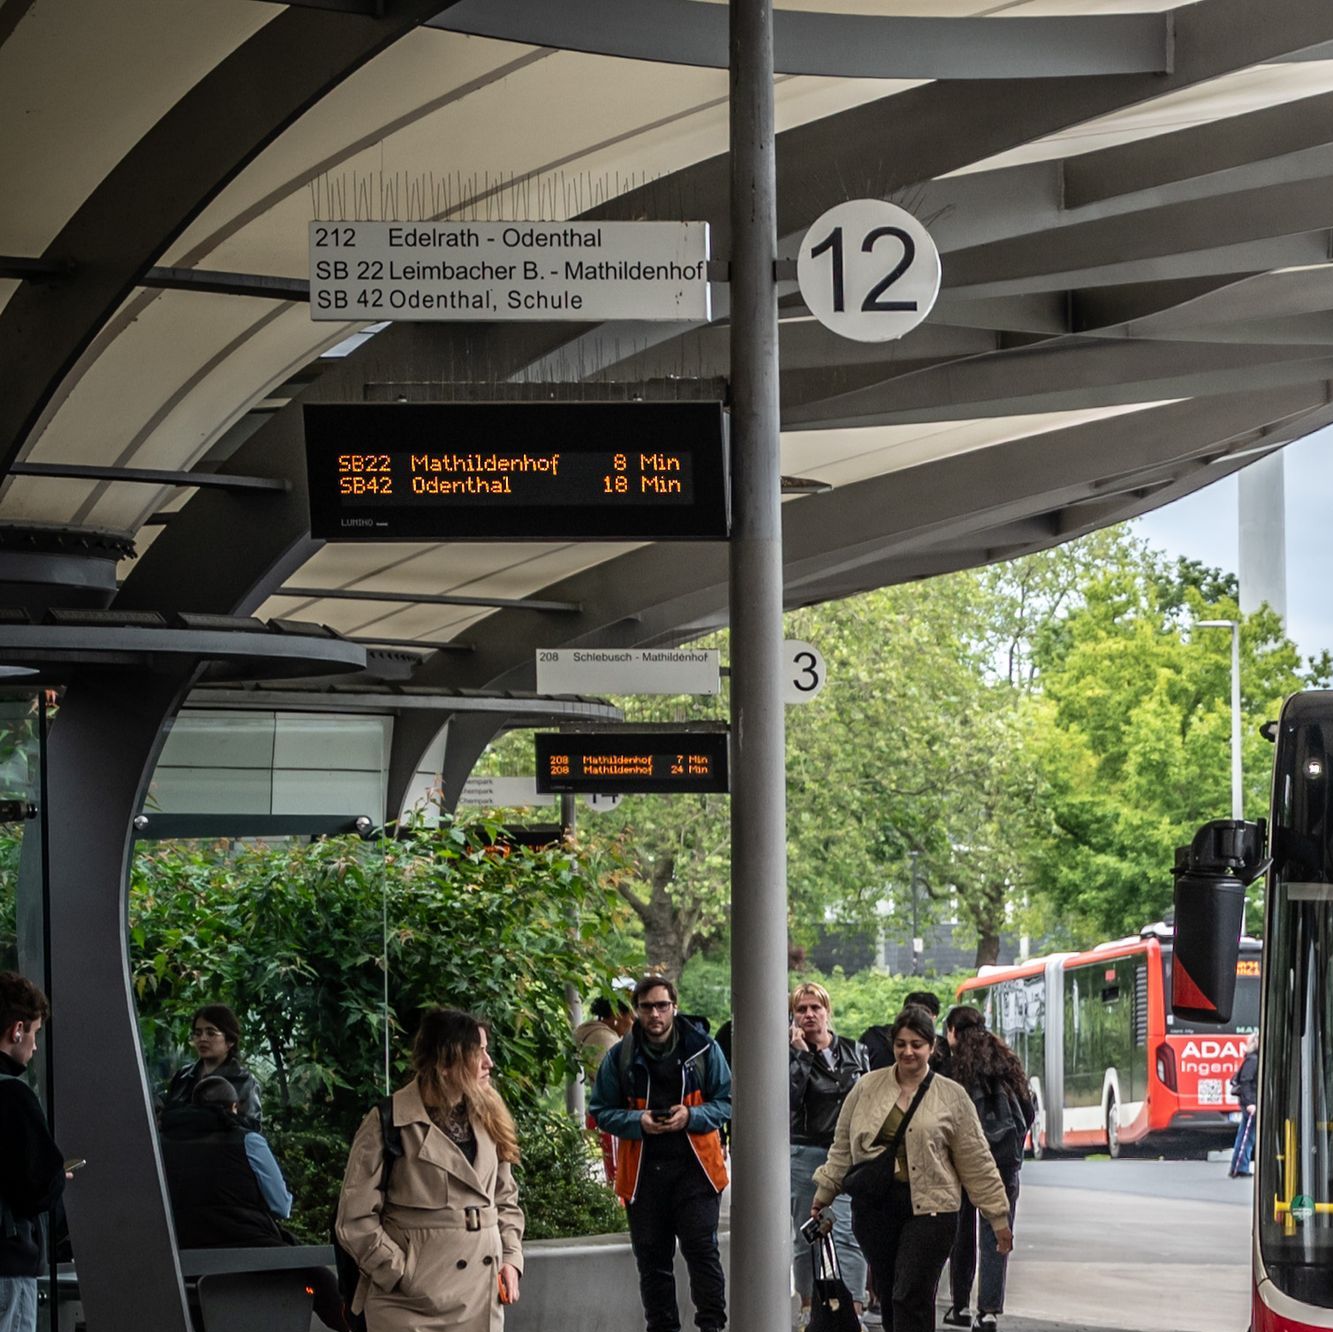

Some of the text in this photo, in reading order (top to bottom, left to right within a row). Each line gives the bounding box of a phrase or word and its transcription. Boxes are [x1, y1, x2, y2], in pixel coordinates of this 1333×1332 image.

[315, 228, 356, 248] 212
[389, 228, 480, 248] Edelrath
[502, 228, 602, 248] Odenthal
[316, 261, 349, 280] SB
[357, 261, 384, 280] 22
[389, 260, 516, 281] Leimbacher
[523, 261, 545, 280] B.
[564, 260, 704, 281] Mathildenhof
[810, 225, 918, 313] 12
[317, 289, 583, 312] SB 42 Odenthal, Schule
[338, 453, 680, 475] SB22 Mathildenhof 8 Min
[339, 475, 681, 494] SB42 Odenthal 18 Min
[539, 653, 559, 662] 208
[573, 652, 633, 662] Schlebusch
[642, 652, 708, 662] Mathildenhof
[792, 652, 820, 692] 3
[549, 755, 708, 766] 208 Mathildenhof 7 Min
[550, 765, 708, 776] 208 Mathildenhof 24 Min
